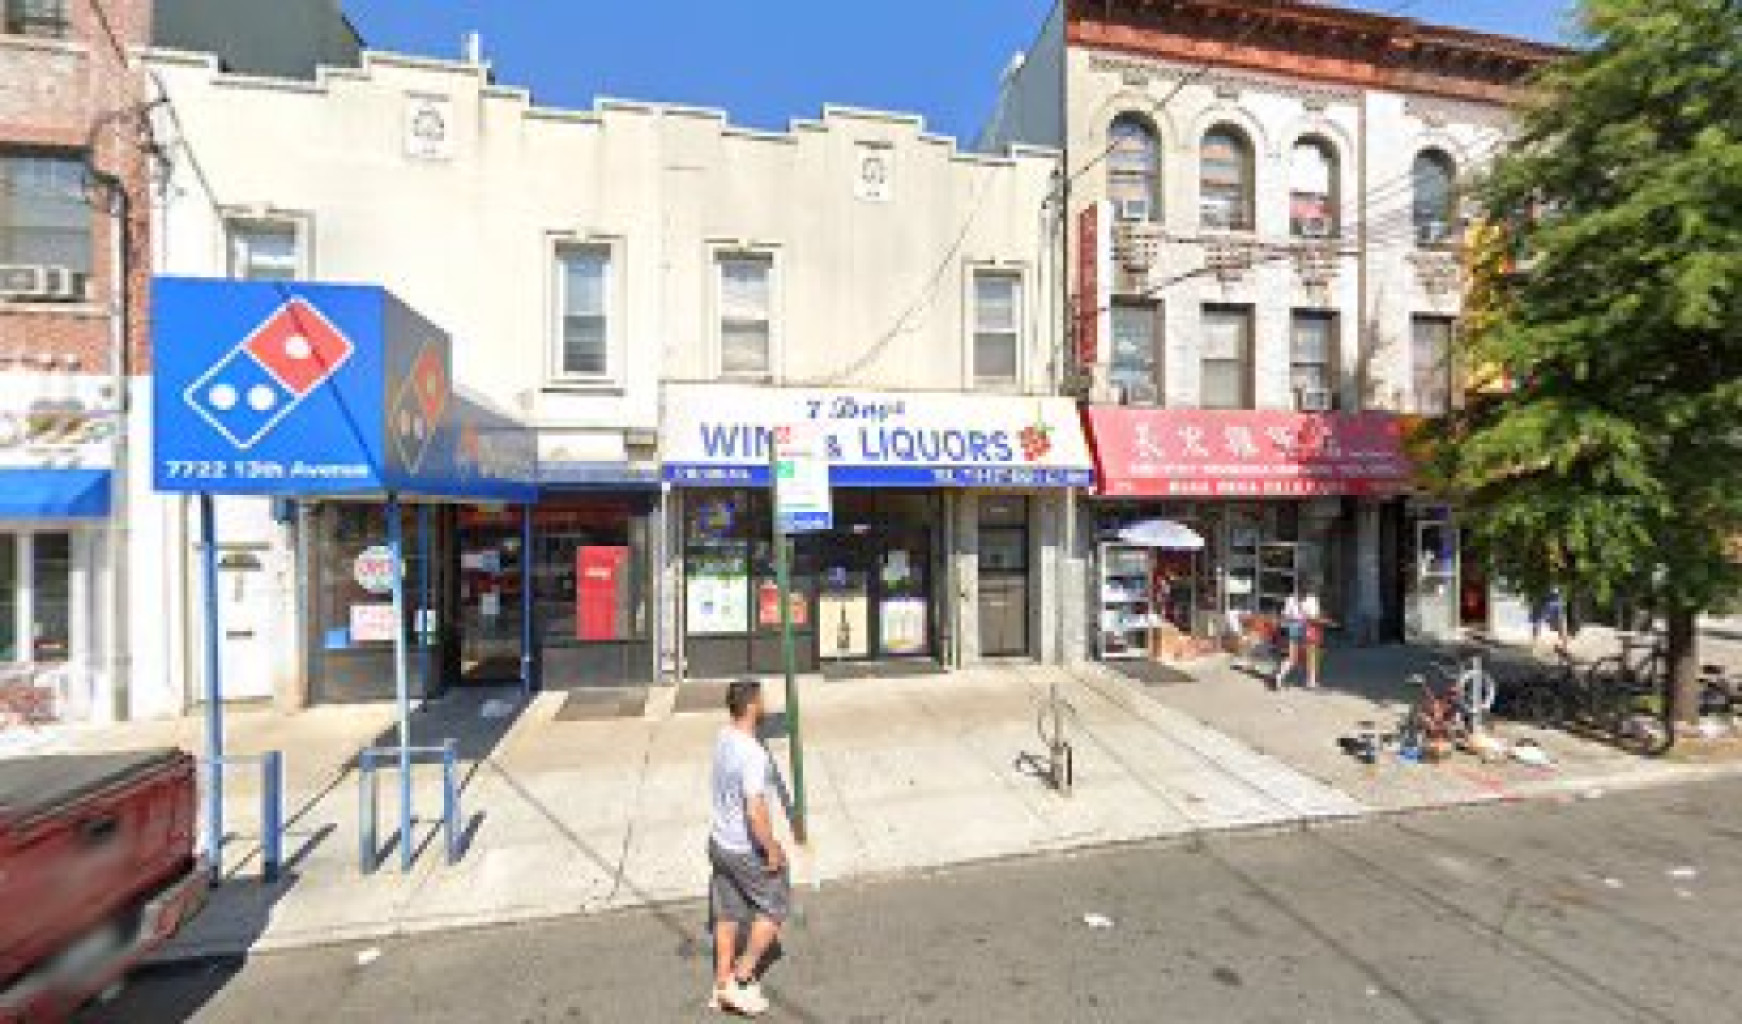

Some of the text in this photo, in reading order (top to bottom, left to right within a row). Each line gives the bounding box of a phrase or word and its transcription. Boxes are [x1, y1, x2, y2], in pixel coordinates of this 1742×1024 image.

[805, 400, 821, 419] 7
[824, 434, 843, 457] &
[859, 425, 1013, 461] LIQUORS
[165, 460, 227, 479] 7722
[290, 460, 369, 479] Avenue
